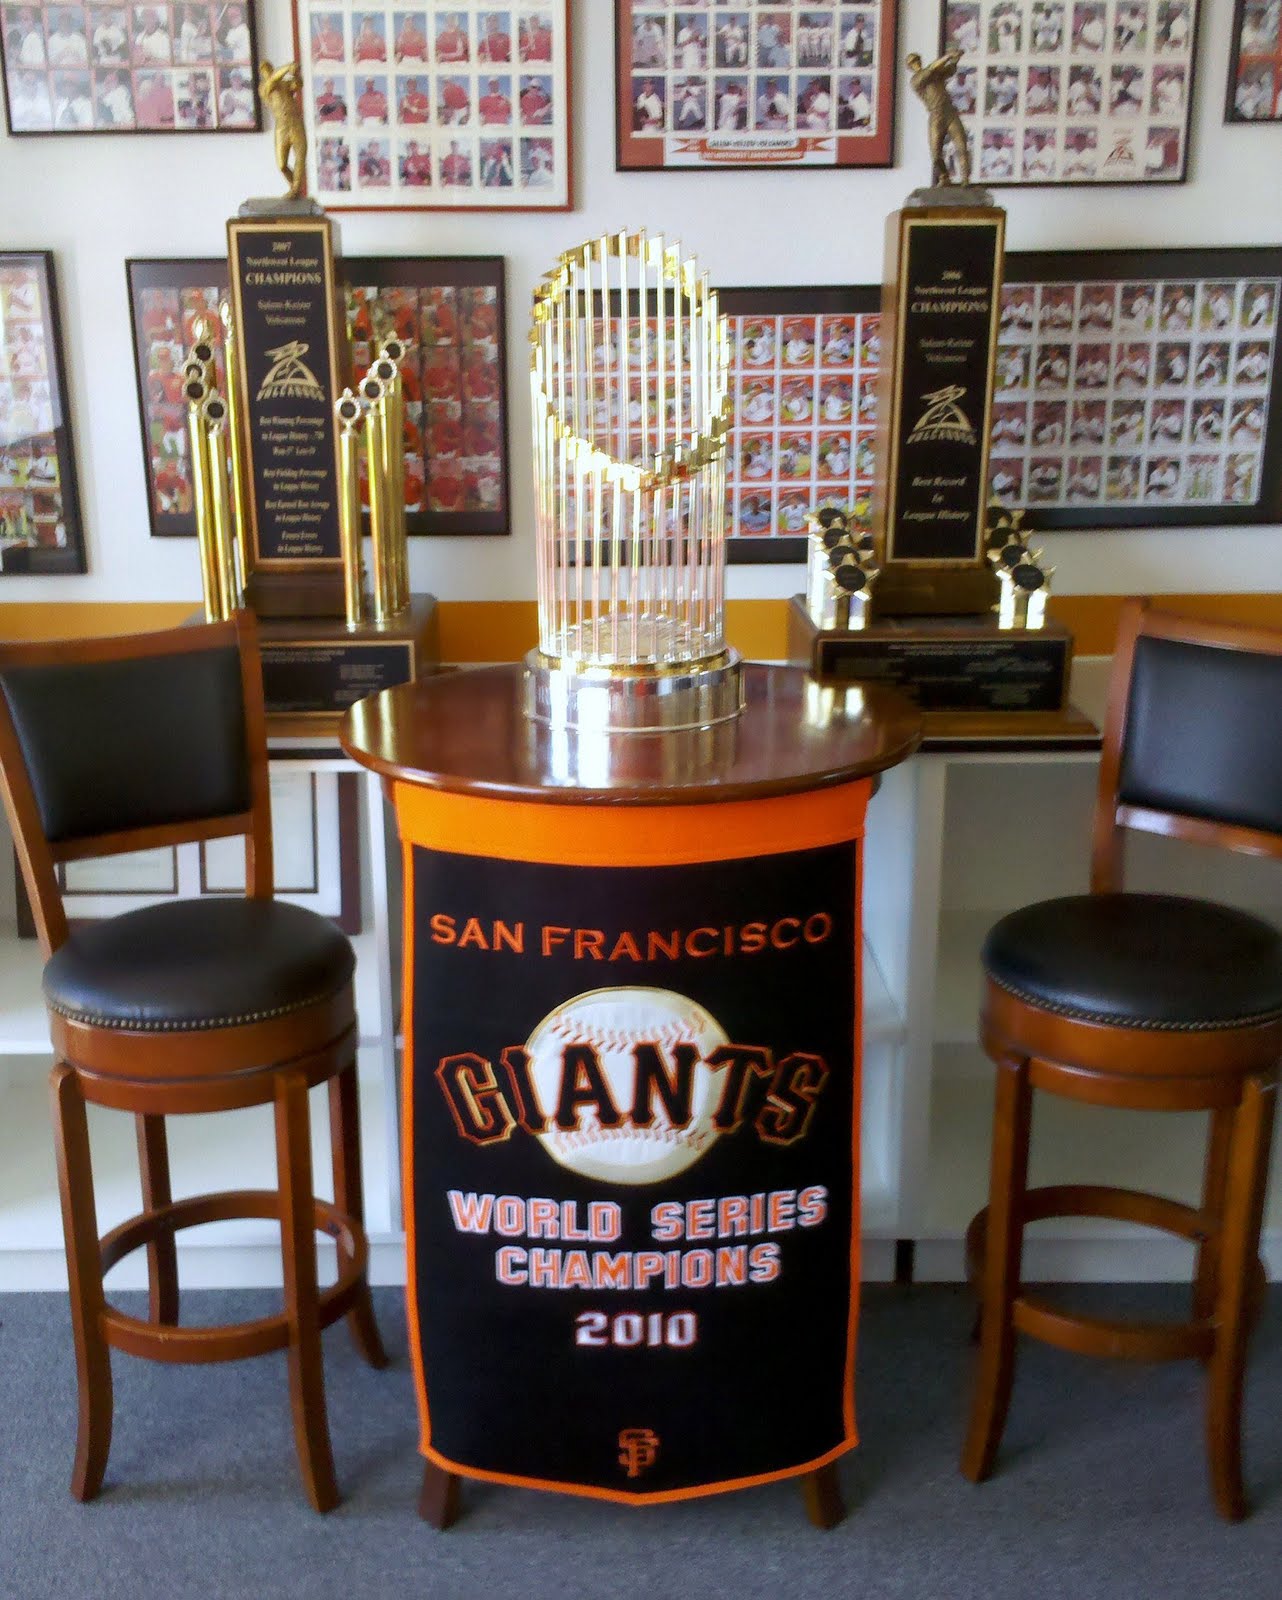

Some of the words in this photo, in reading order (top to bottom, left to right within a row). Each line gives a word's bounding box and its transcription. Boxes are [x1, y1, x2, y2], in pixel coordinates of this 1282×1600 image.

[245, 272, 322, 285] CHAMPIONS
[289, 256, 319, 268] League
[911, 302, 989, 313] CHAMPIONS
[430, 913, 524, 954] SAN
[541, 912, 833, 962] FRANCISCO
[434, 1043, 830, 1147] GIANTS
[447, 1189, 622, 1242] WORLD
[651, 1185, 828, 1241] SERIES
[495, 1242, 783, 1290] CHAMPIONS
[575, 1310, 699, 1348] 2010
